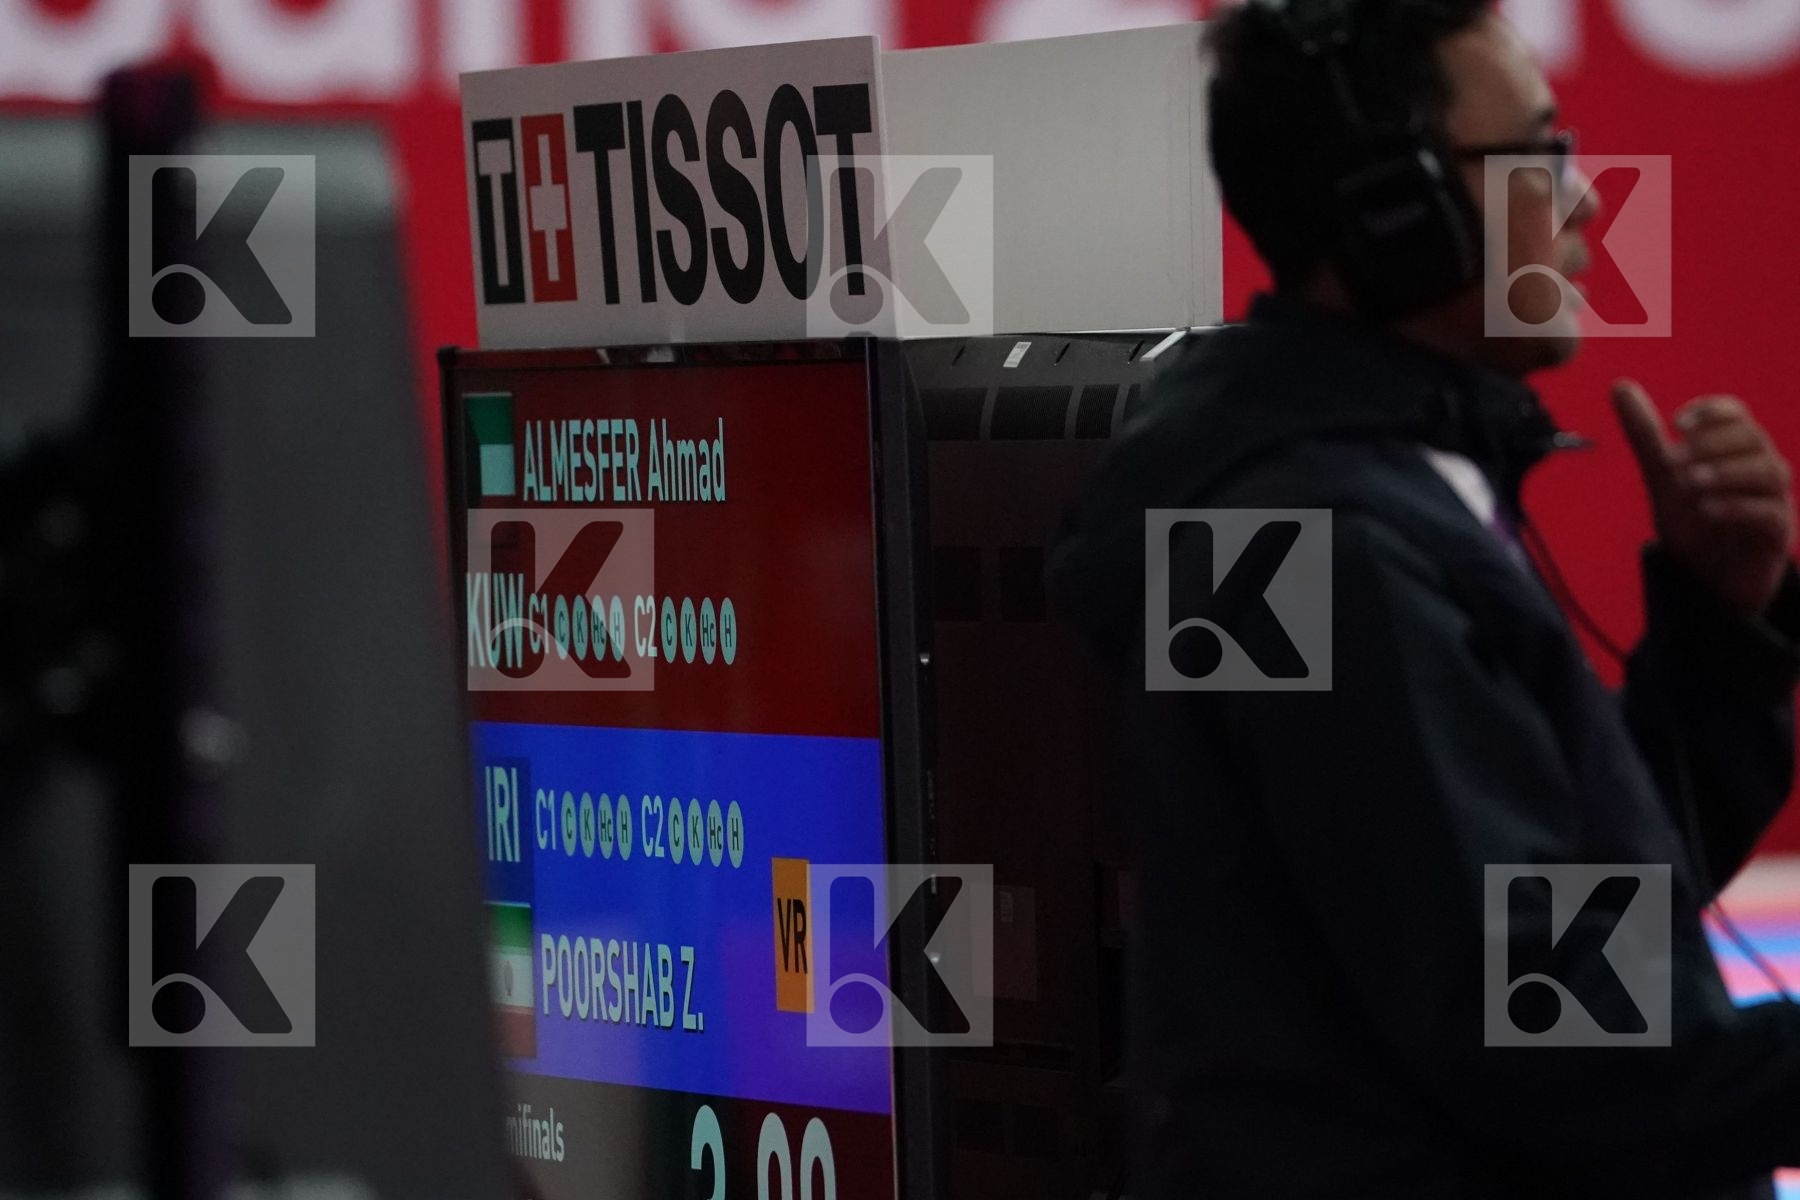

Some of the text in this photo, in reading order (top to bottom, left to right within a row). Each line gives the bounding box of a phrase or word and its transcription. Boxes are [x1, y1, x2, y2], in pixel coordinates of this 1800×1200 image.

[574, 83, 872, 306] TISSOT
[523, 416, 726, 502] ALMESFER Ahmad
[466, 572, 524, 669] KUW
[634, 594, 658, 658] C2
[484, 765, 521, 863] IRI
[535, 787, 556, 851] C1
[641, 794, 665, 858] C2
[540, 932, 705, 1033] POORSHAB Z.
[776, 897, 808, 974] VR
